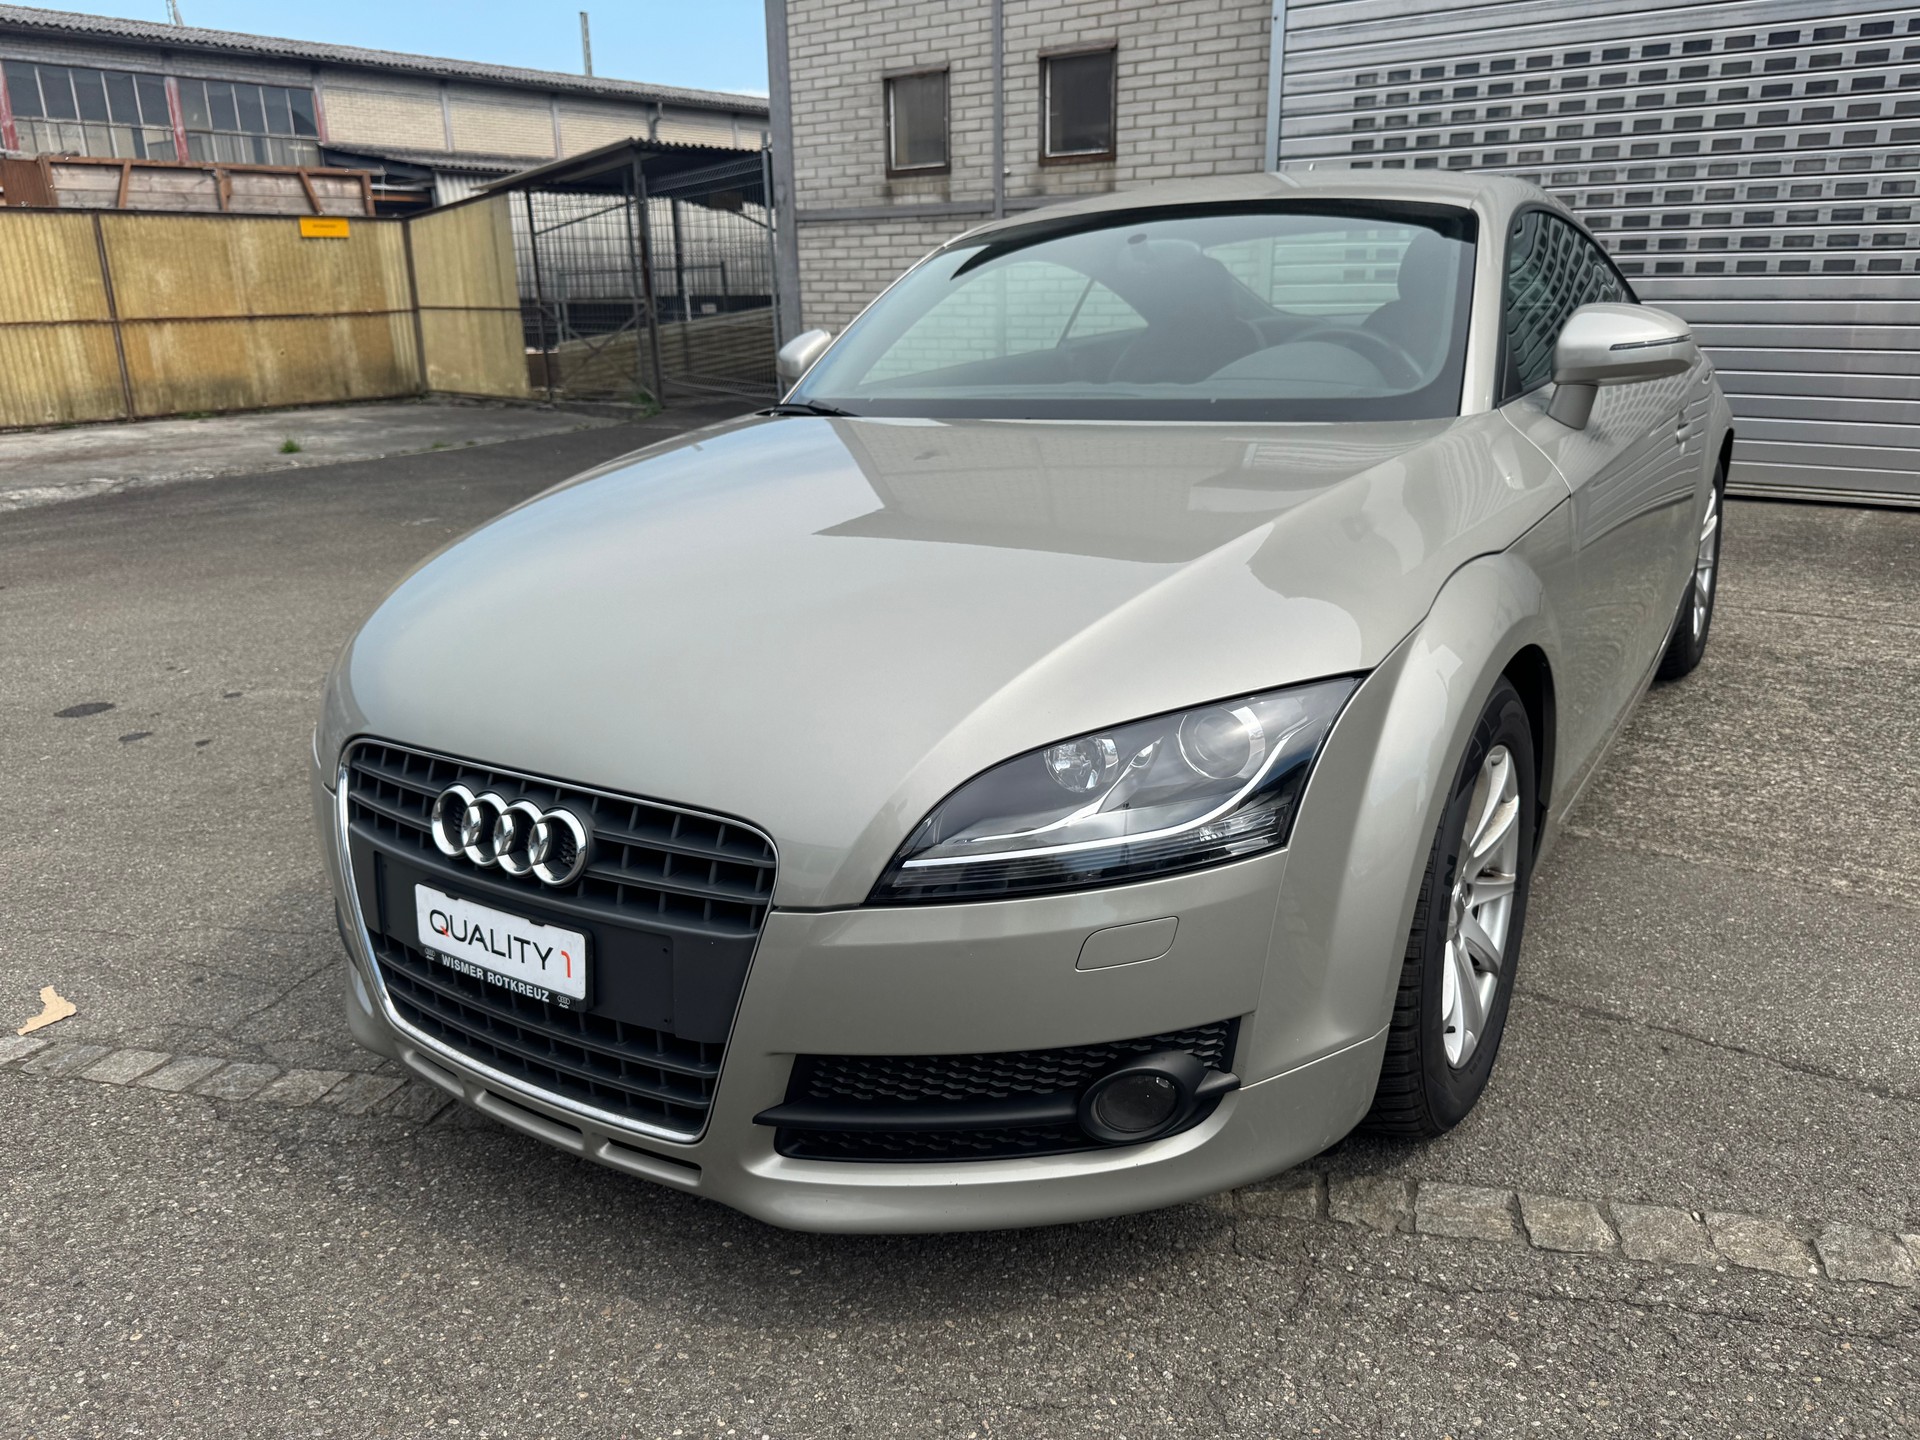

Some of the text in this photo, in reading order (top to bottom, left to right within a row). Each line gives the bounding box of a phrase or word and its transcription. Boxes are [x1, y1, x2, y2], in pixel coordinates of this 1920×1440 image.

[429, 909, 554, 971] QUALITY
[441, 954, 550, 1003] WISMER ROTKREUZ
